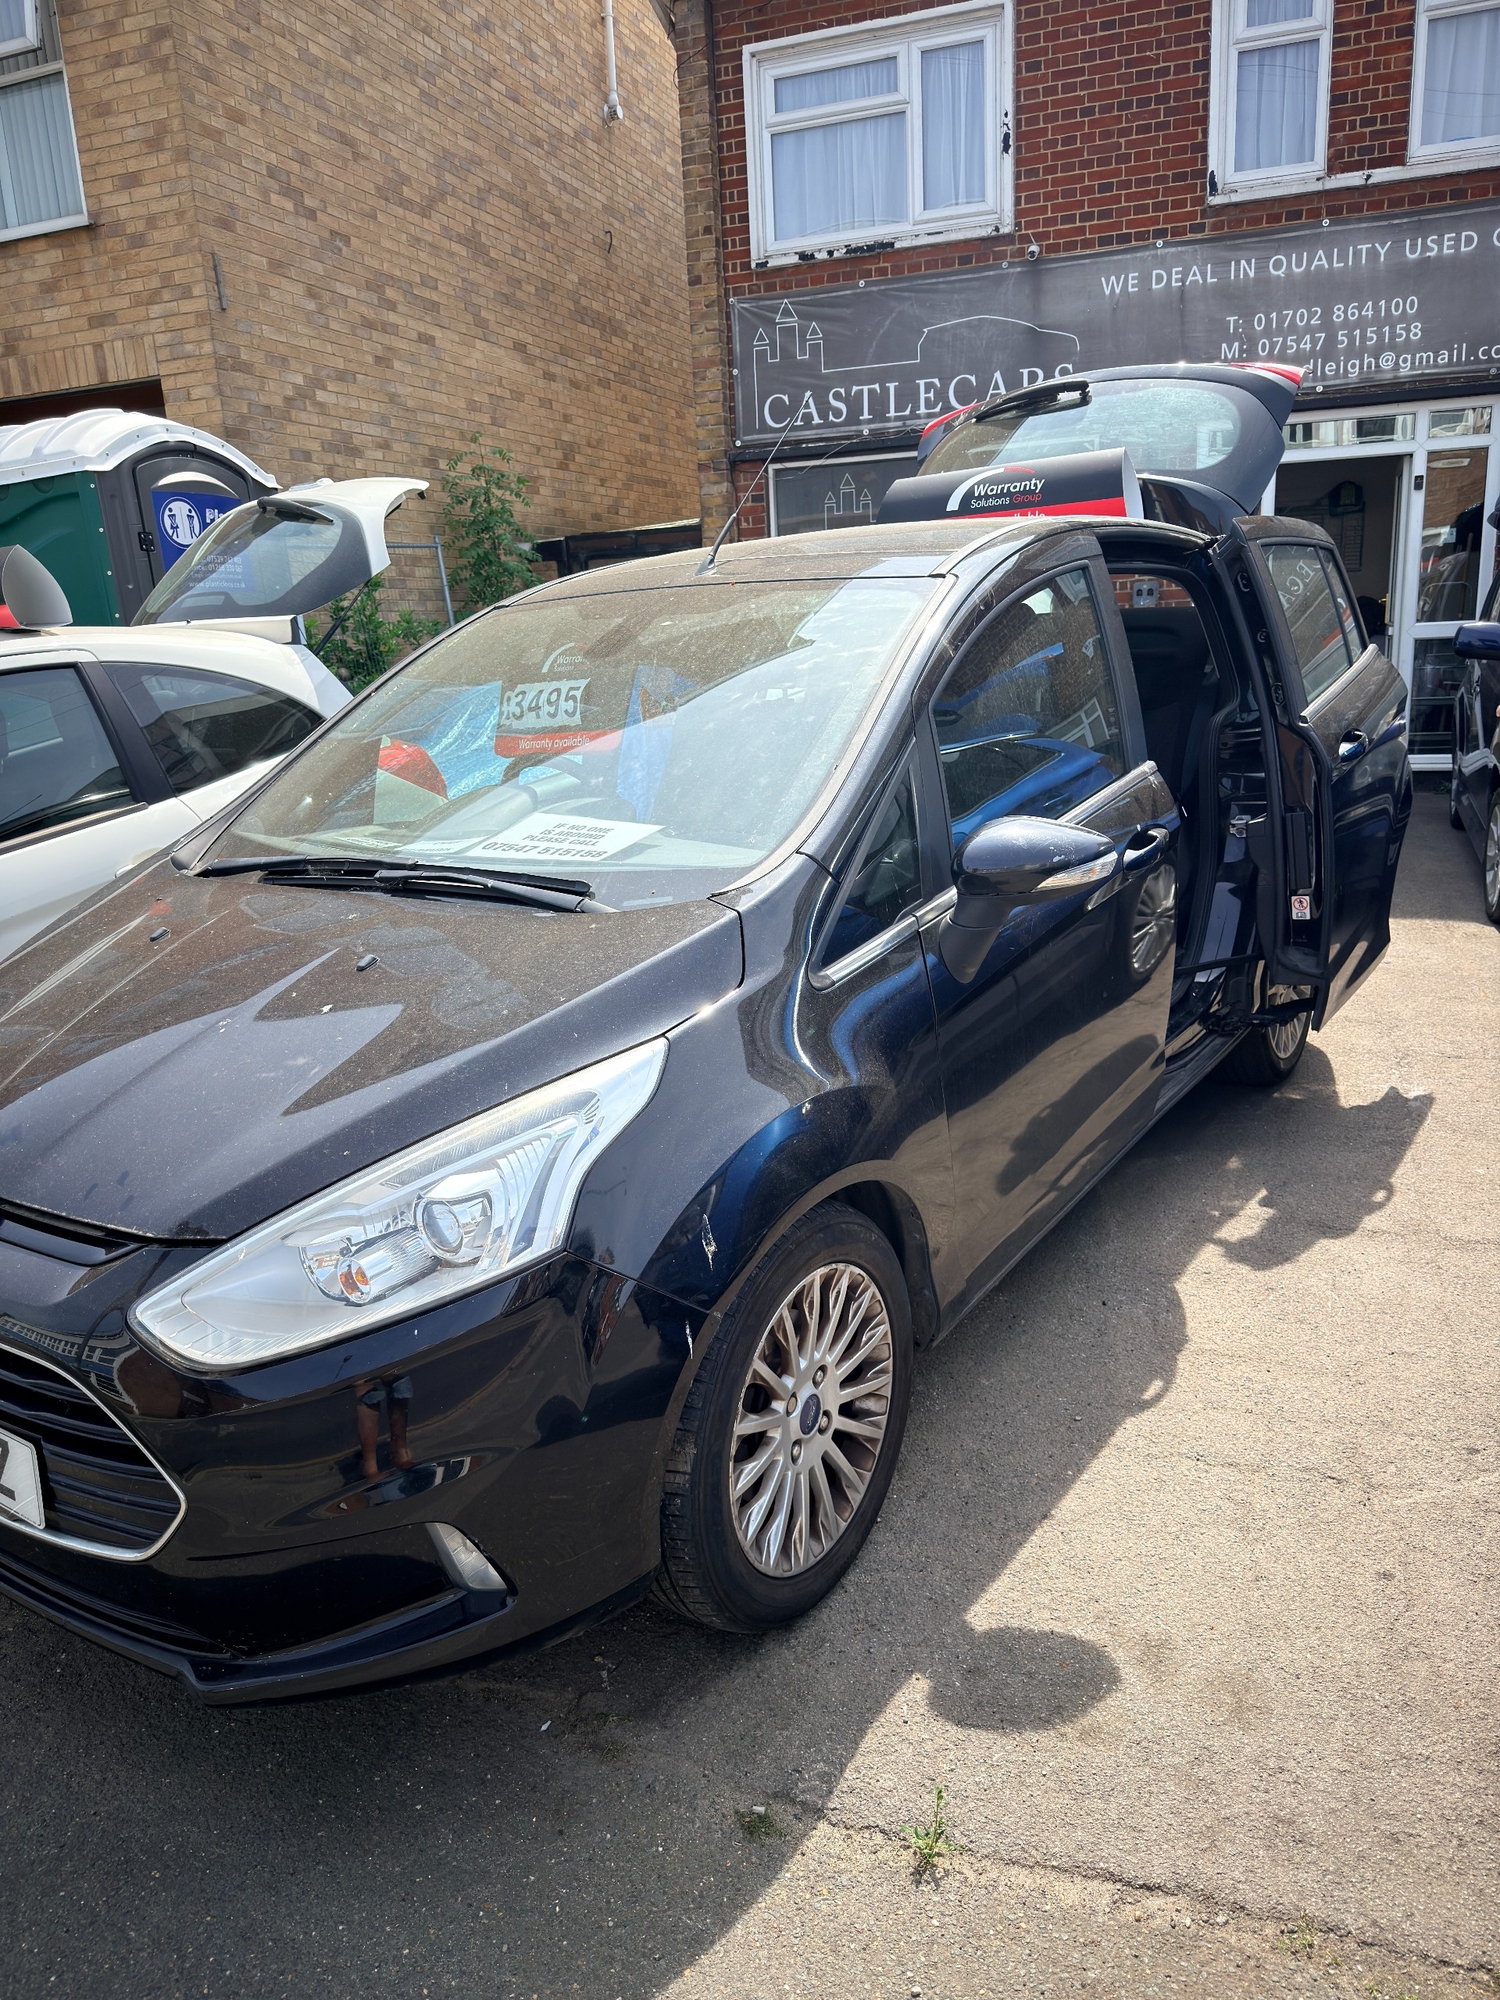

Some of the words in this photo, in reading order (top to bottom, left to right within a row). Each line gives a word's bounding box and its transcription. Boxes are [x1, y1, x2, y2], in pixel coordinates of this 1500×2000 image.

[1101, 272, 1139, 295] WE
[1152, 263, 1218, 289] DEAL
[1230, 258, 1256, 280] IN
[1268, 241, 1392, 277] QUALITY
[1405, 231, 1478, 259] USED
[1226, 316, 1243, 333] T:
[1253, 307, 1322, 331] 01702
[1332, 296, 1419, 322] 864100
[1221, 342, 1247, 359] M:
[1257, 333, 1326, 356] 07547
[1337, 322, 1422, 348] 515158
[974, 478, 1045, 496] Warranty
[971, 496, 1010, 509] Solutions
[1012, 493, 1042, 505] Group
[518, 739, 552, 749] Warranty
[553, 735, 590, 747] available
[552, 830, 606, 840] AROUND
[586, 826, 615, 834] ONE
[522, 834, 570, 844] PLEASE
[568, 839, 600, 847] CALL
[481, 841, 541, 853] 07547
[537, 846, 609, 858] 515158
